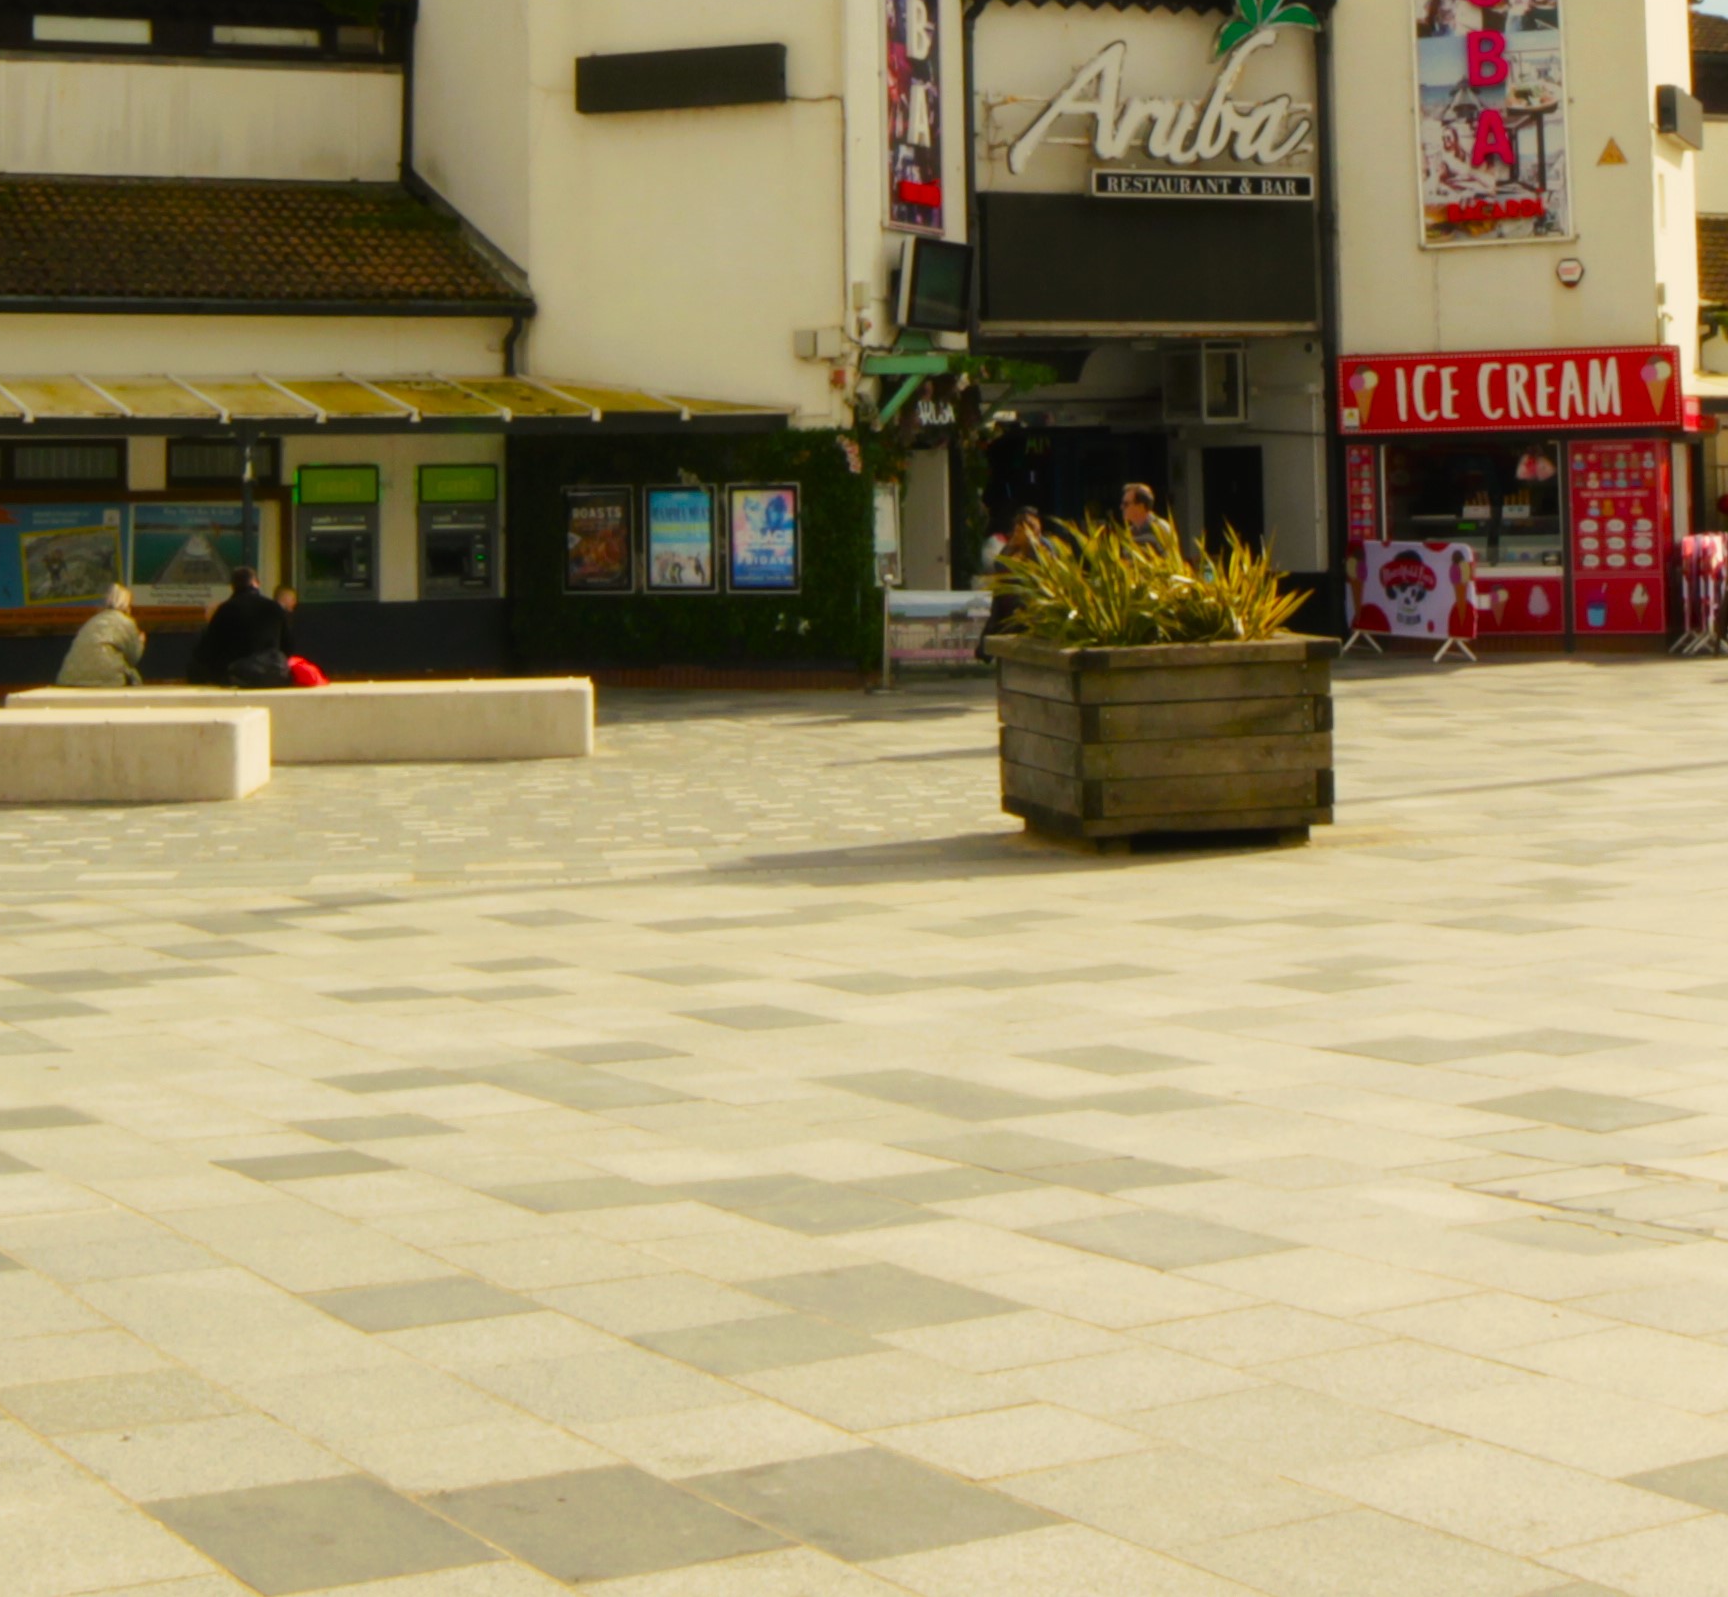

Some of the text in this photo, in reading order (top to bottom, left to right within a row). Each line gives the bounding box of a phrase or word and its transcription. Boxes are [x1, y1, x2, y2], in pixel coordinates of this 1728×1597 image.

[1008, 29, 1312, 175] Aruba
[1106, 175, 1297, 196] RESTAURANT & BAR
[1394, 356, 1622, 423] ICE CREAM
[571, 505, 623, 520] ROASTS
